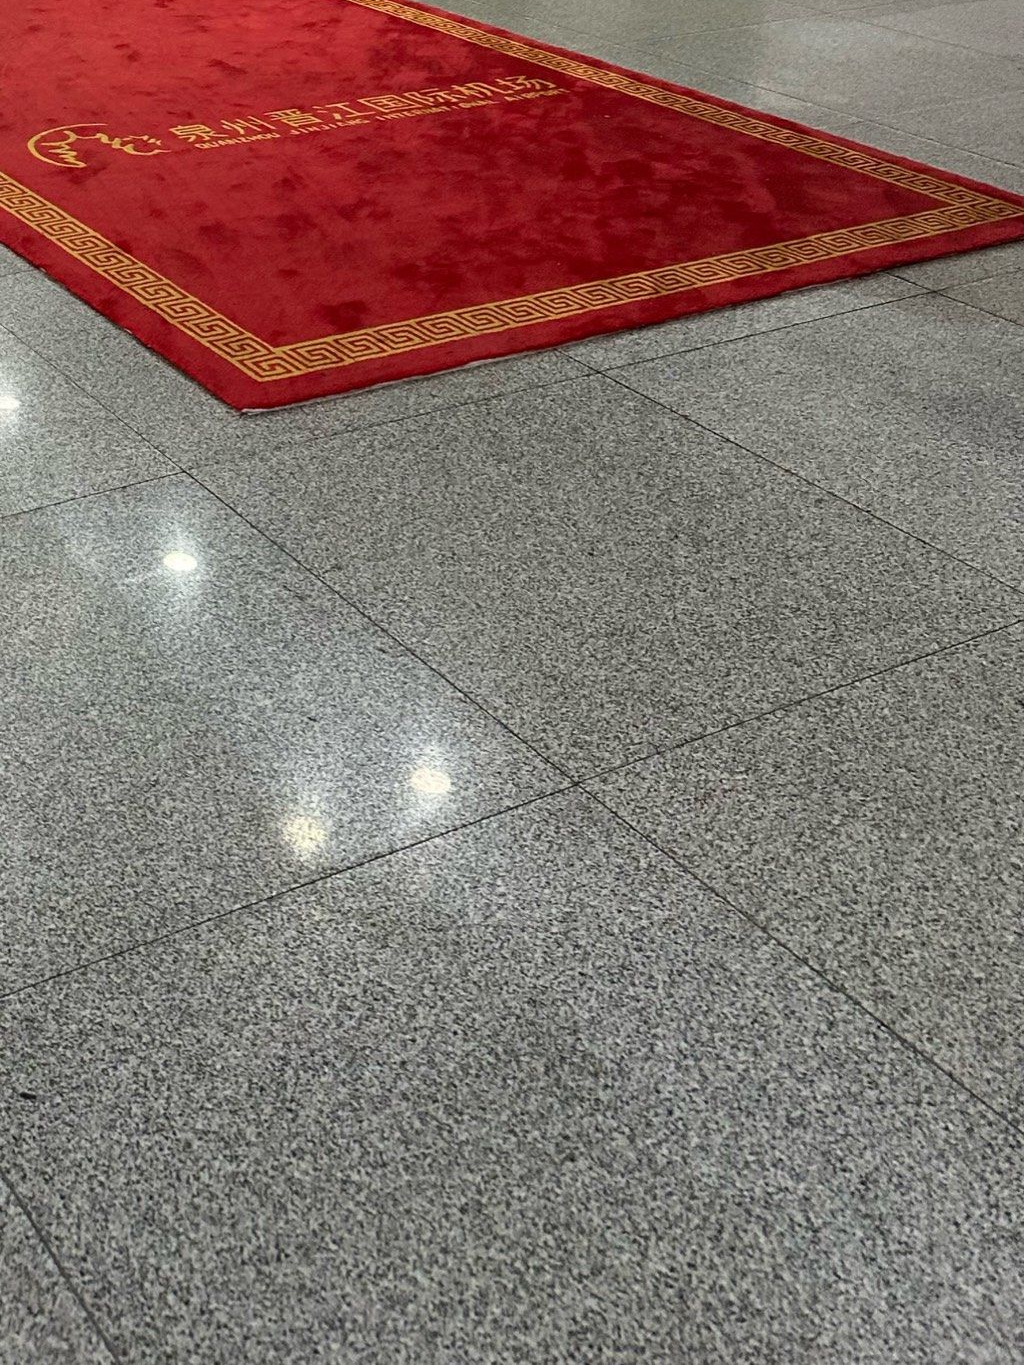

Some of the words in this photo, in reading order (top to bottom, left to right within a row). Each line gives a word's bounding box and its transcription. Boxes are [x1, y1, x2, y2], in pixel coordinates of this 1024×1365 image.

[168, 74, 557, 143] 泉州晋江国际机场
[193, 131, 281, 150] QUANZHOU
[289, 118, 371, 136] JINJIANG
